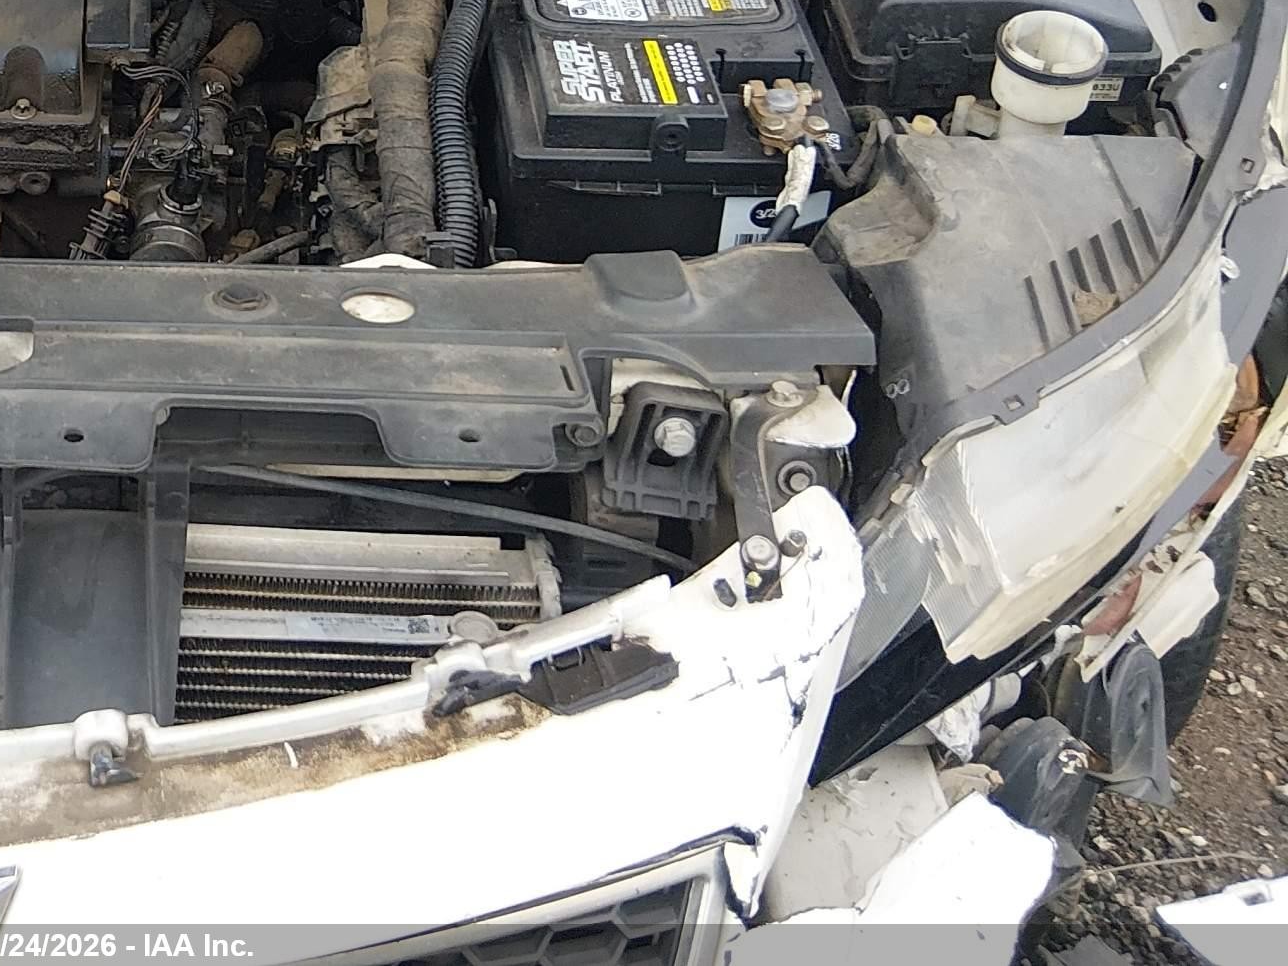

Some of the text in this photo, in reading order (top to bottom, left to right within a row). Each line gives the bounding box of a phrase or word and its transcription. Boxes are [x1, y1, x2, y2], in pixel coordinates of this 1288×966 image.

[552, 39, 580, 95] SUPER
[569, 40, 606, 104] START
[596, 50, 624, 103] PLATINUM
[755, 208, 777, 220] 3/2
